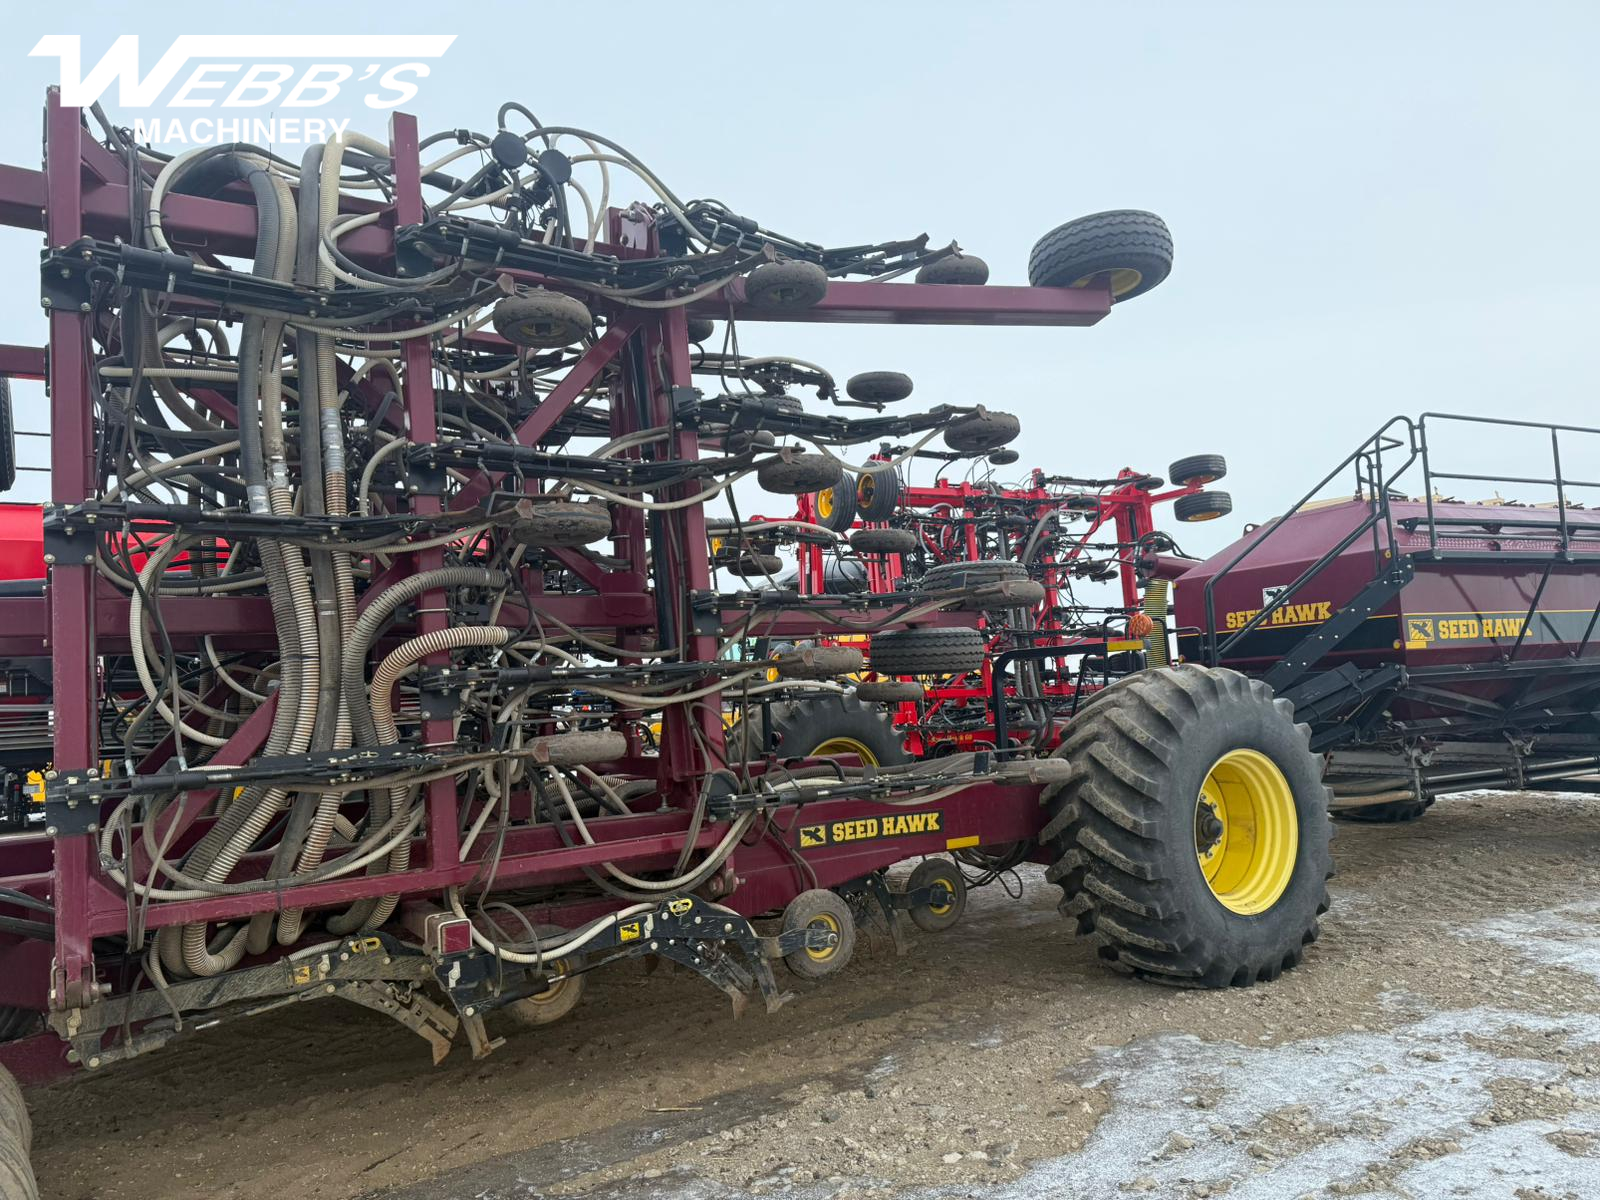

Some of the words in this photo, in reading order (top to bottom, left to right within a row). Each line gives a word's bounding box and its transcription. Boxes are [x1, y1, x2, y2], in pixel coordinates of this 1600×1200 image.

[1271, 601, 1333, 625] HAWK
[1438, 619, 1479, 640] SEED
[832, 818, 878, 842] SEED
[882, 812, 940, 836] HAWK
